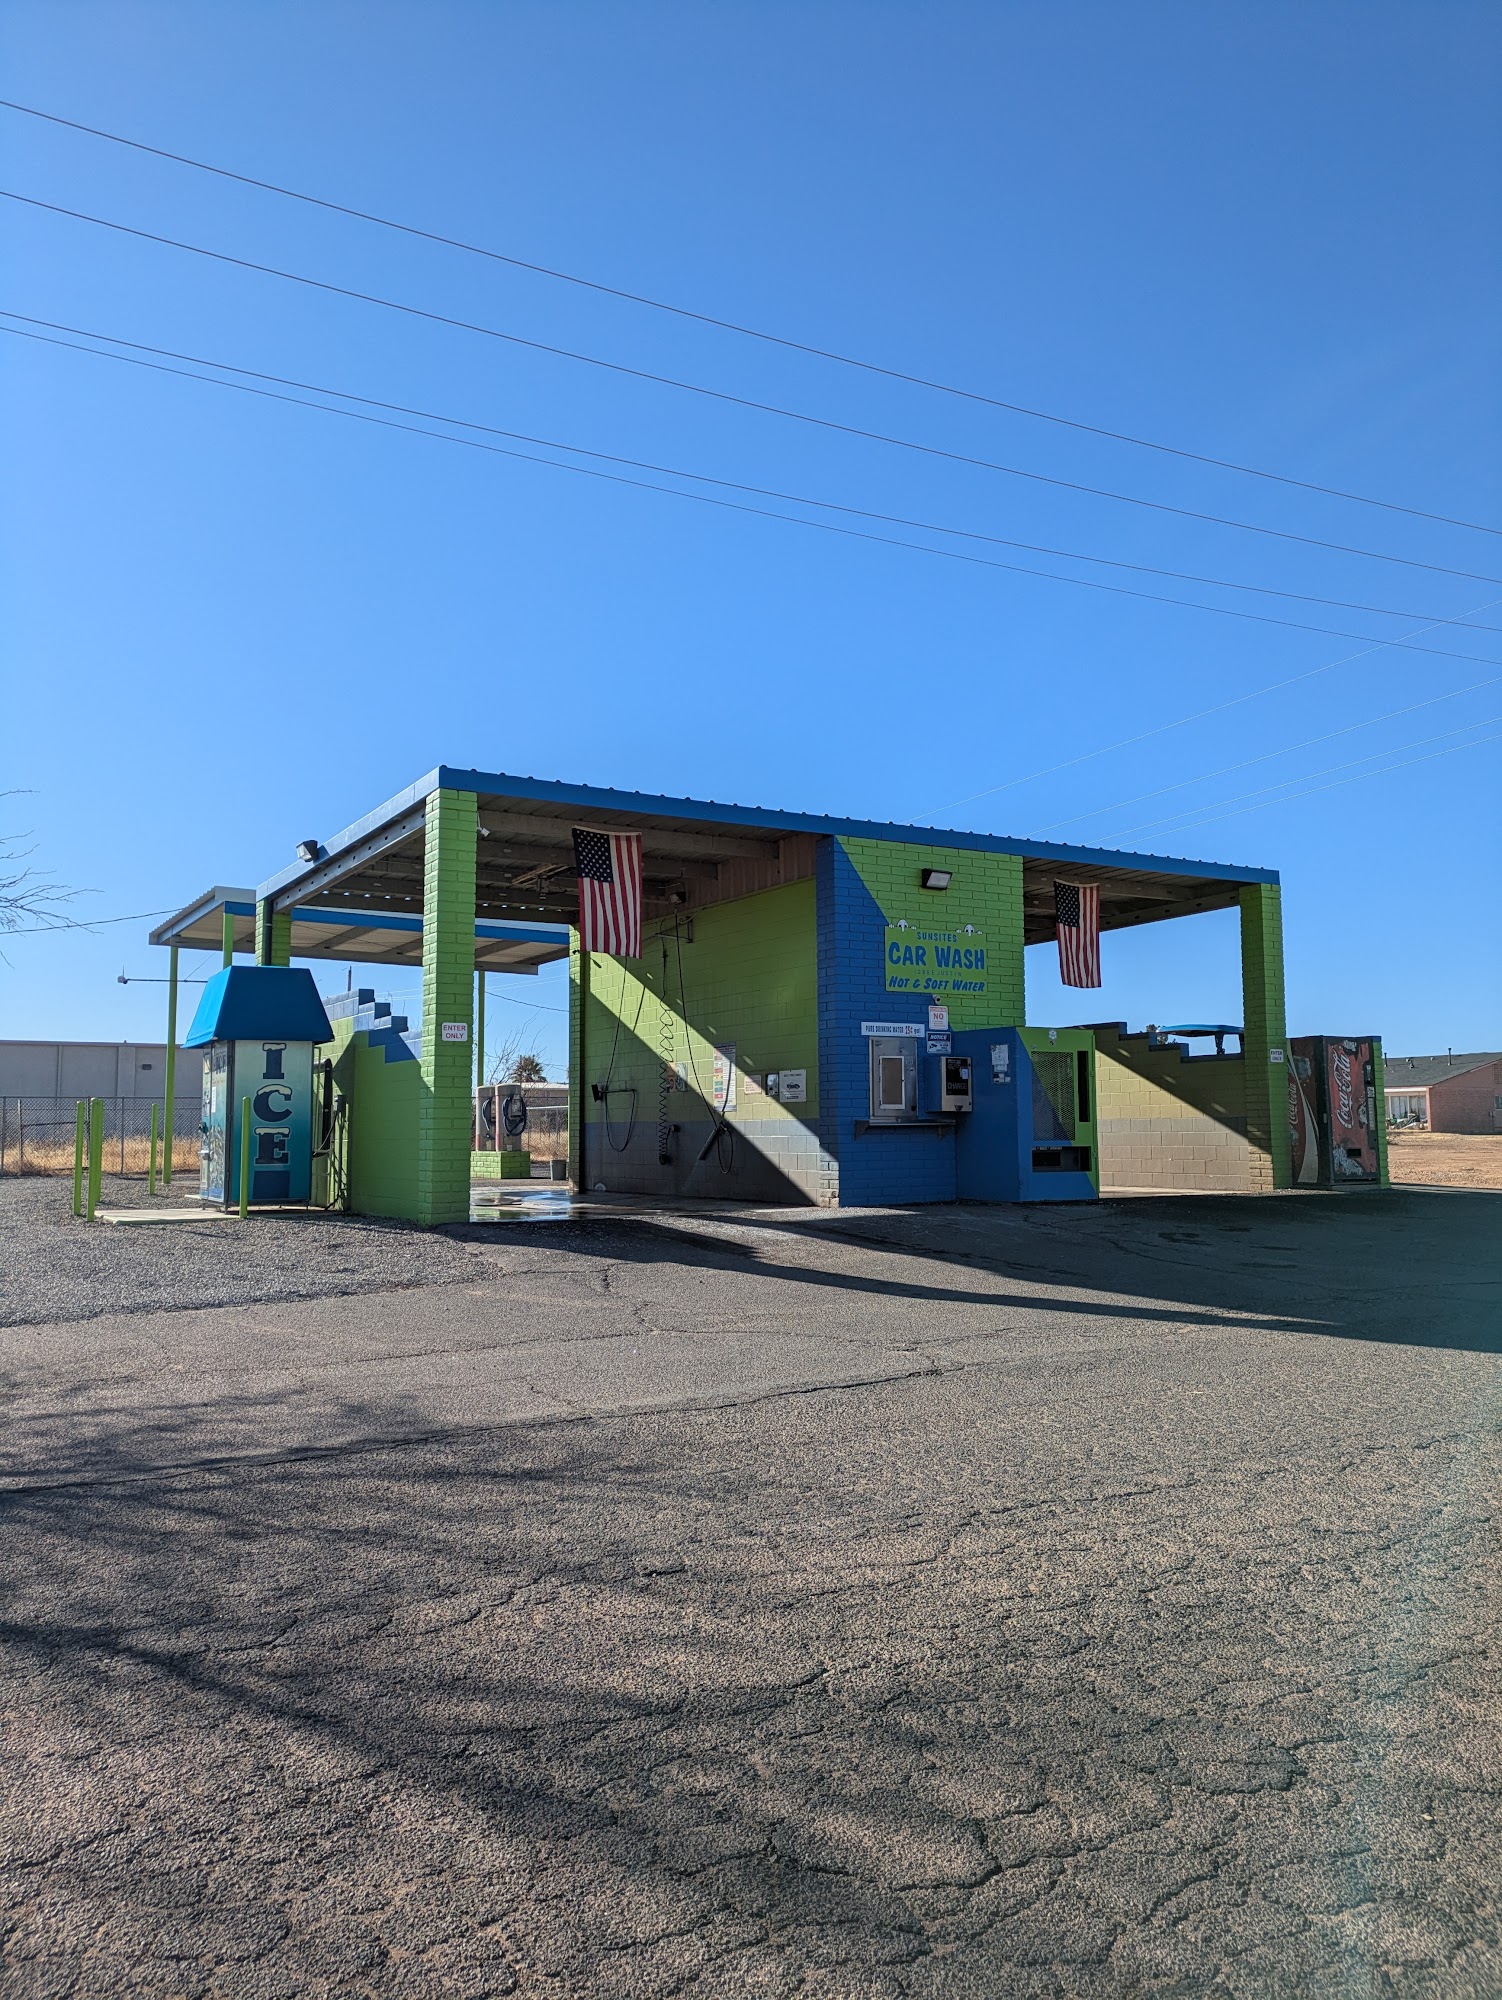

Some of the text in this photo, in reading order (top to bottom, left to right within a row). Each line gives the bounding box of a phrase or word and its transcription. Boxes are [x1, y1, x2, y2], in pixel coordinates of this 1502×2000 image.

[917, 932, 957, 942] SUNSITES
[888, 942, 985, 970] CAR WASH
[888, 976, 985, 992] HOT & SOFT WATER
[933, 1012, 944, 1020] NO
[865, 1025, 875, 1033] PURE
[875, 1025, 892, 1033] DRINKING
[892, 1026, 904, 1034] WATER
[947, 1082, 967, 1090] CHANGE
[253, 1042, 293, 1166] ICE
